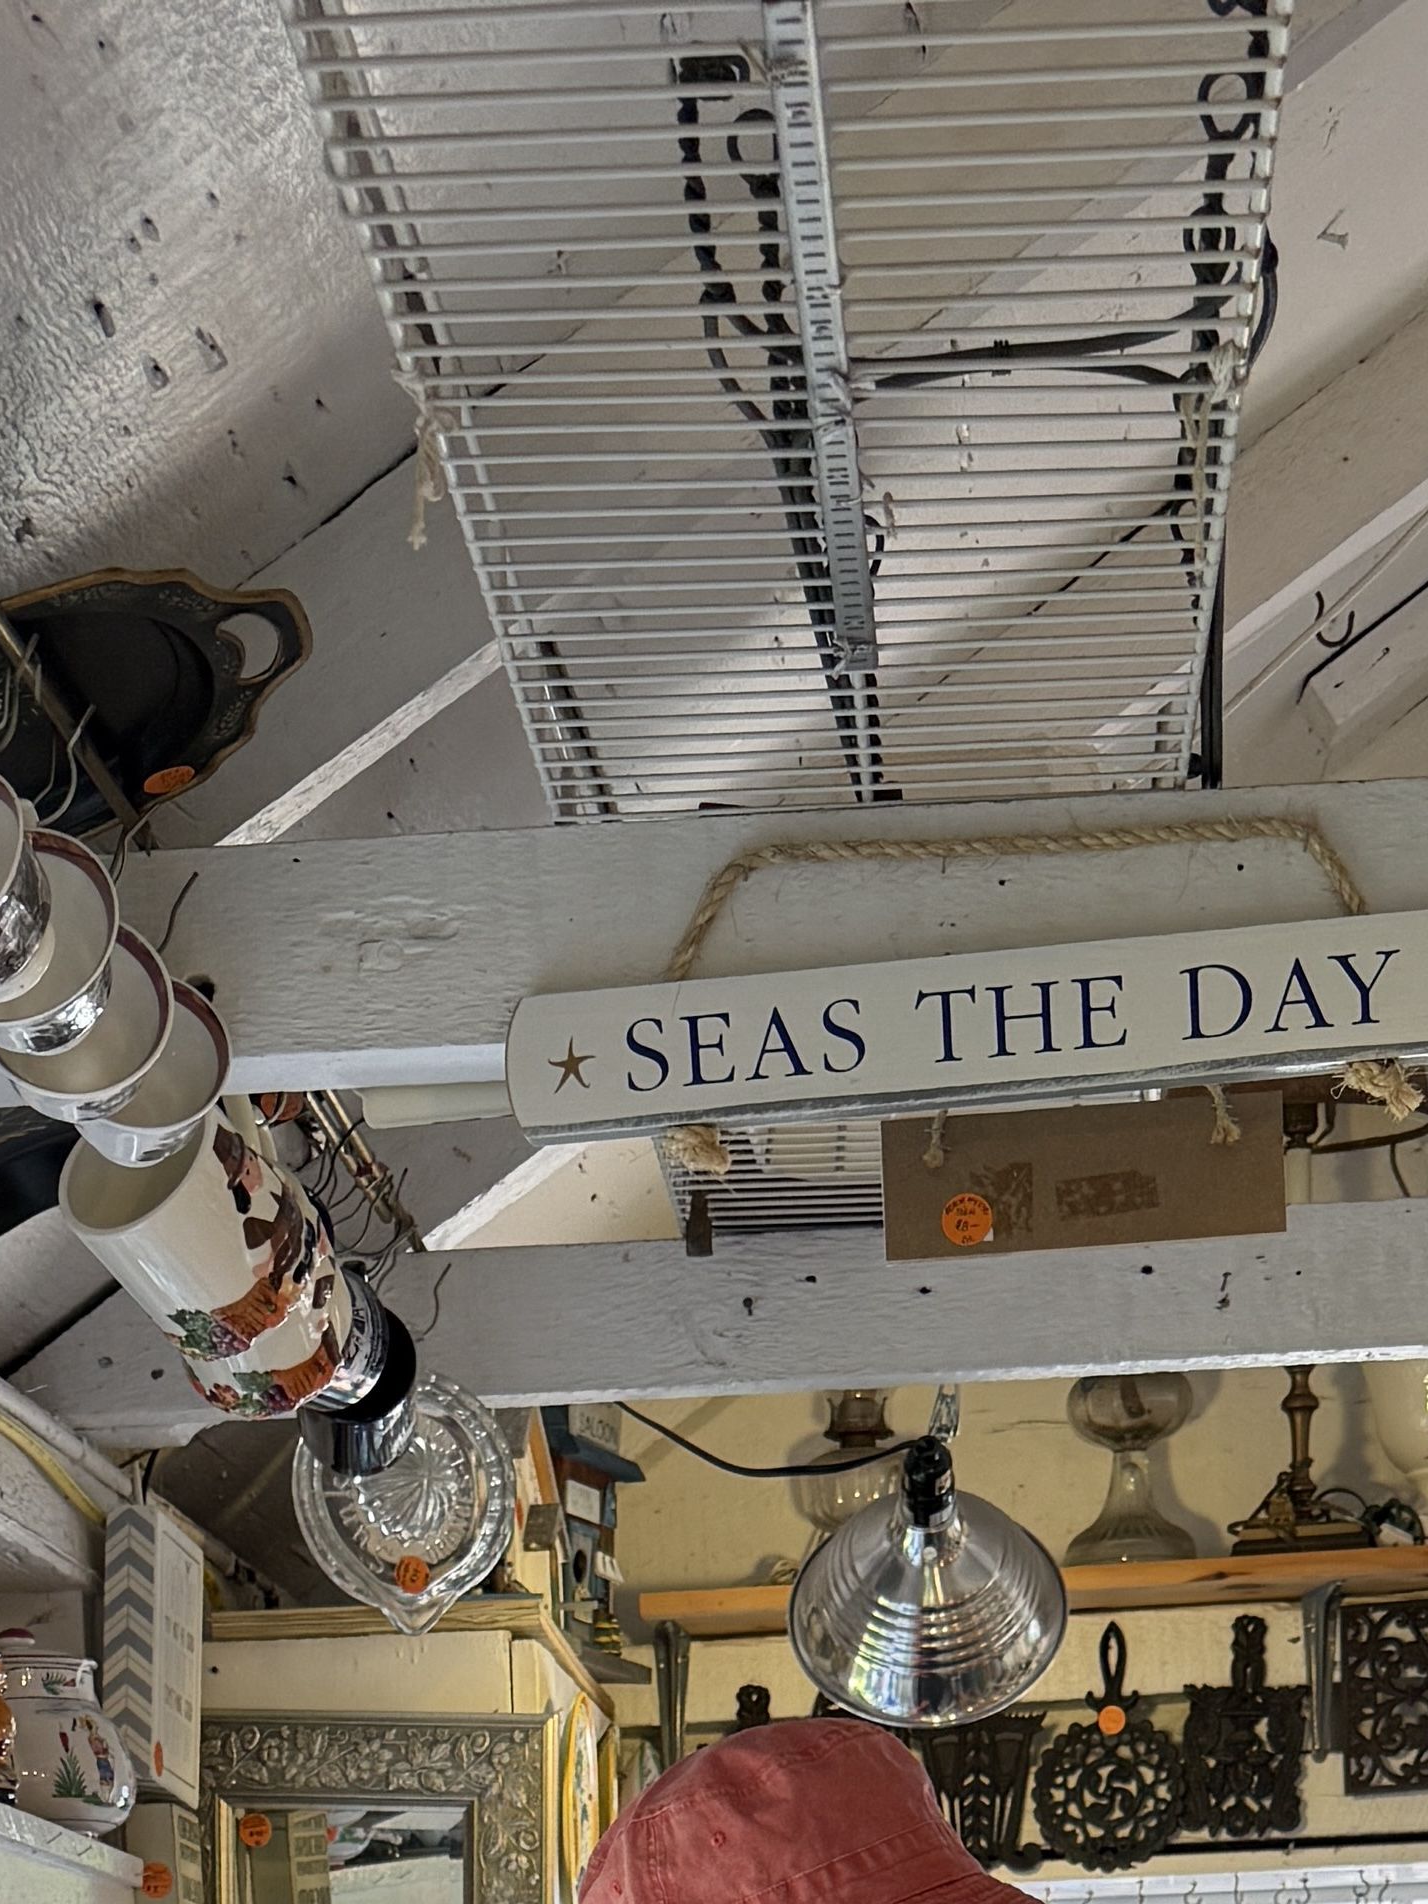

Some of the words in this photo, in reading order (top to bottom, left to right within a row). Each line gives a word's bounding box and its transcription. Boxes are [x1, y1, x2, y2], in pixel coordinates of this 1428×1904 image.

[625, 998, 867, 1092] SEAS
[915, 974, 1129, 1063] THE
[1179, 949, 1401, 1041] DAY
